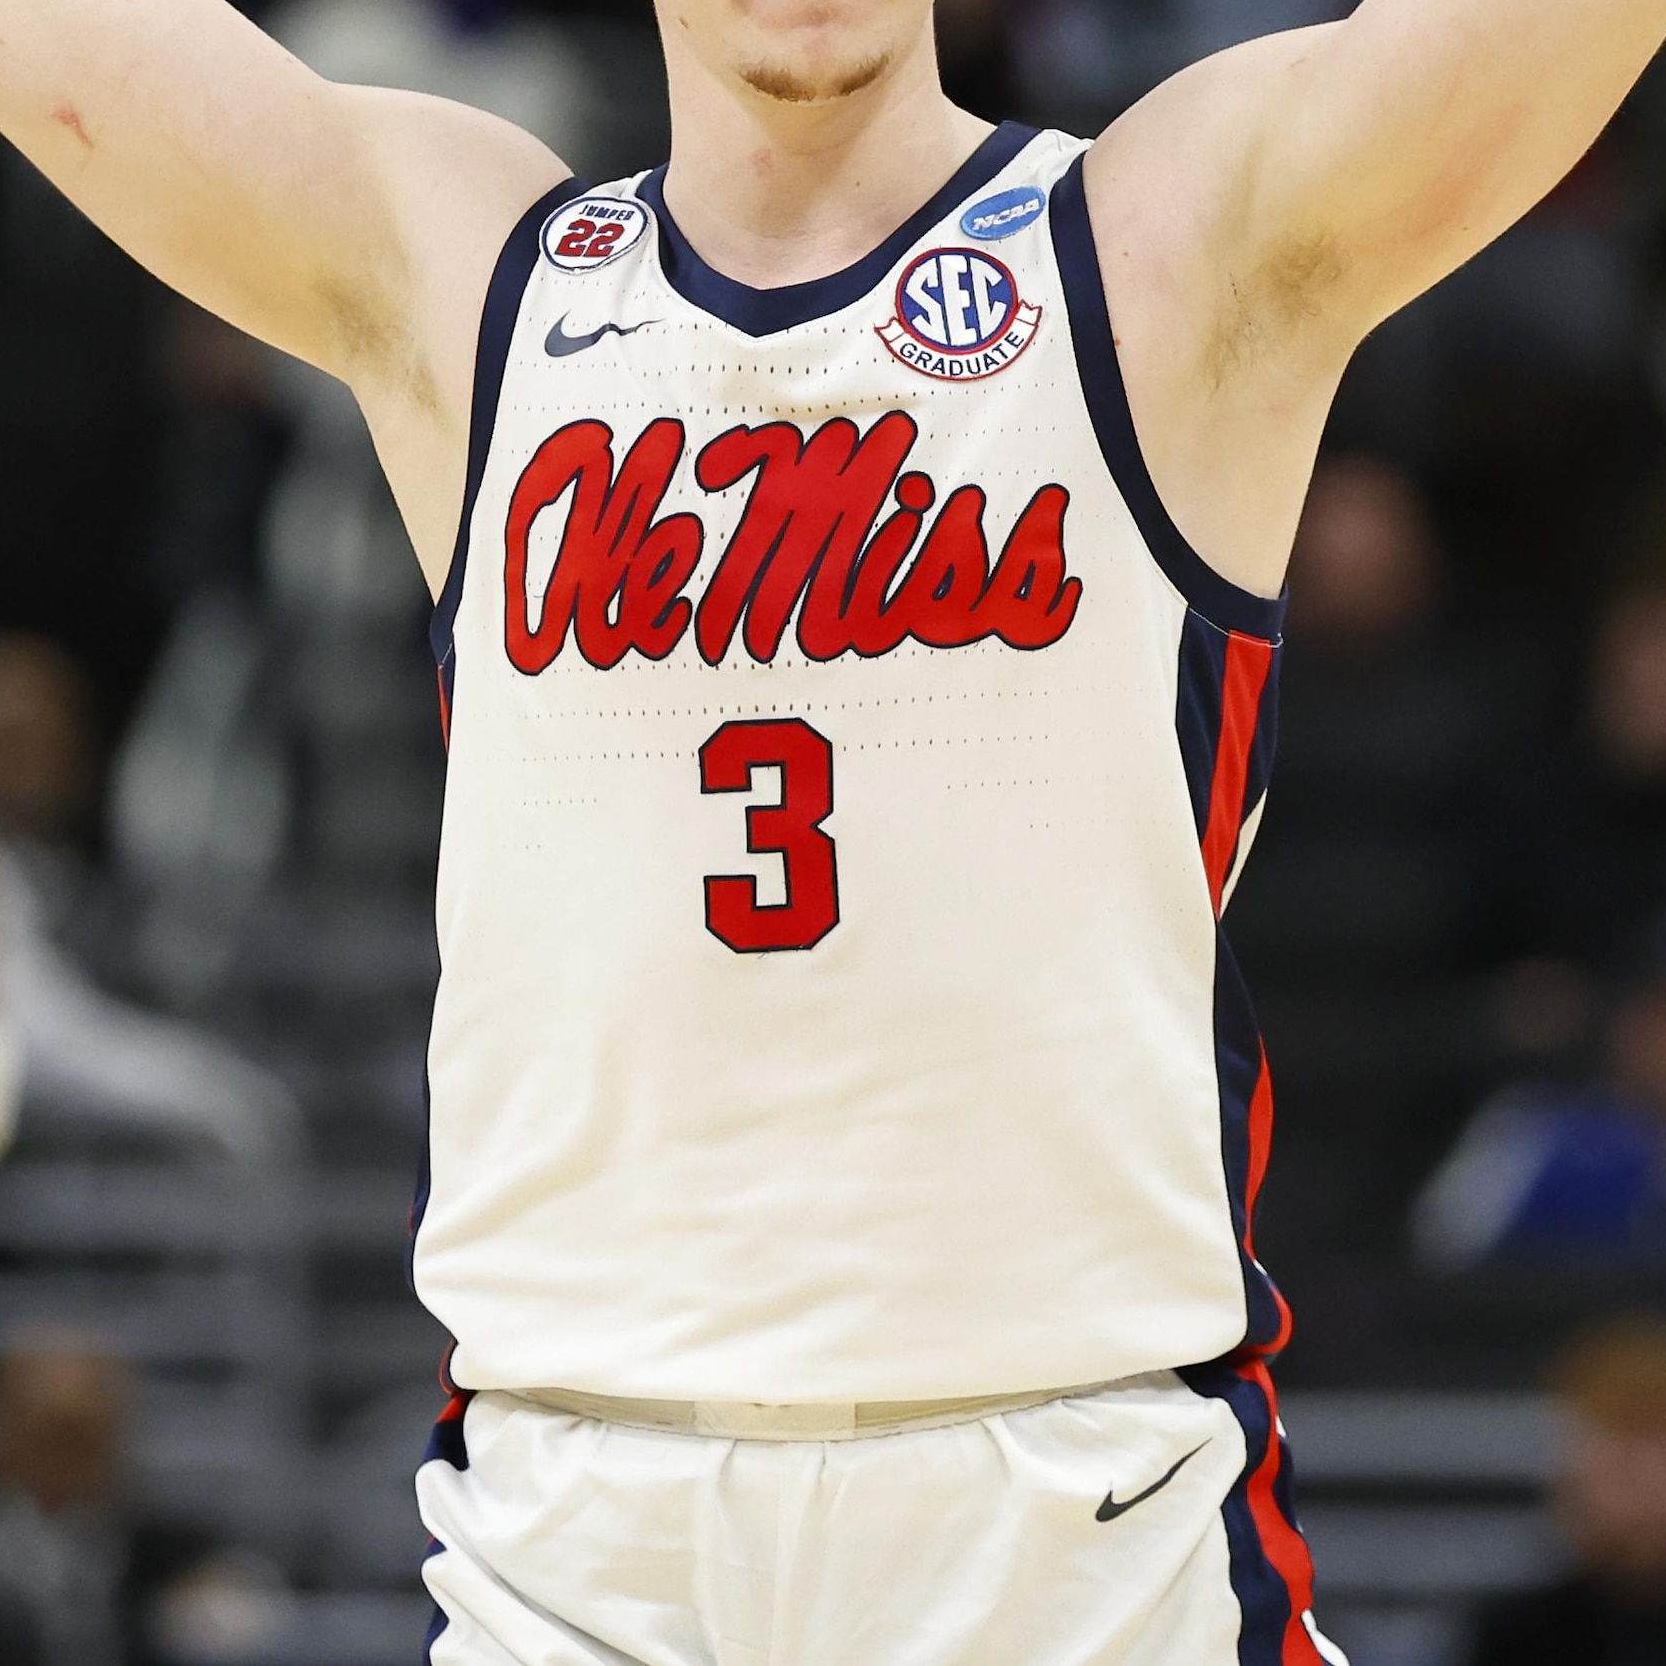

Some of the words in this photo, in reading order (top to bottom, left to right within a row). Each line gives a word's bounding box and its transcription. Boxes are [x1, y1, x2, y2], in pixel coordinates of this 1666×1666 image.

[579, 204, 635, 221] JUMPER
[971, 197, 1040, 231] NCAA
[554, 218, 625, 258] 22
[904, 254, 1008, 347] SEC
[898, 330, 1025, 377] GRADUATE
[503, 417, 703, 677] Ole
[694, 409, 1083, 666] Miss
[697, 718, 840, 954] 3
